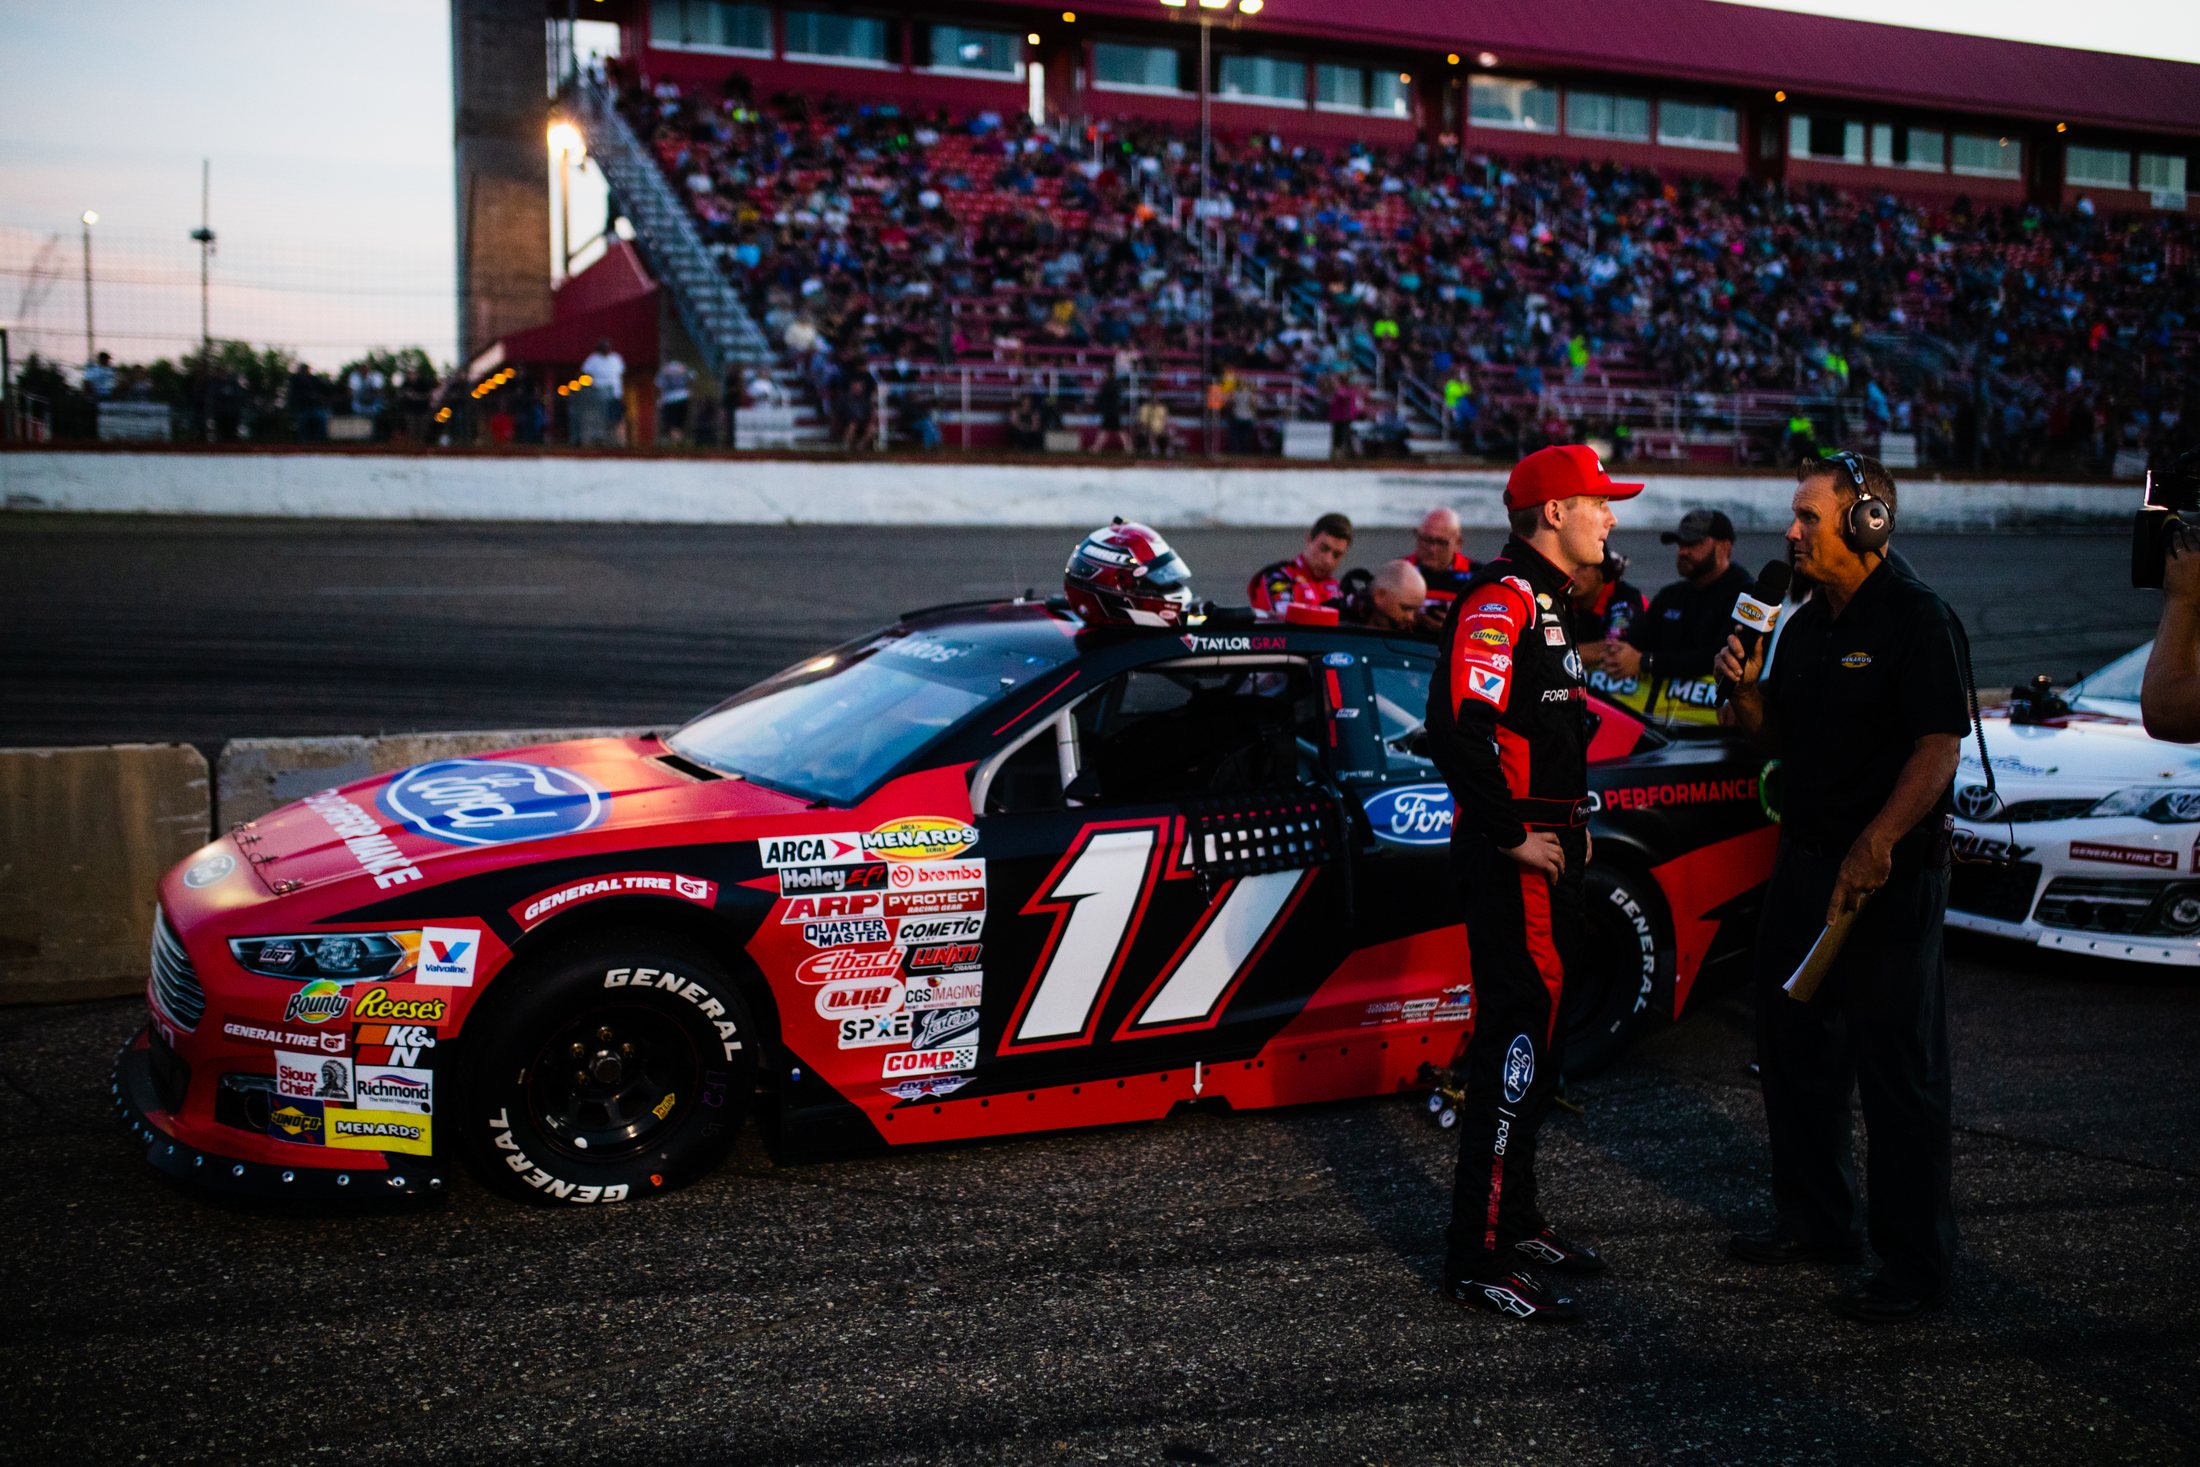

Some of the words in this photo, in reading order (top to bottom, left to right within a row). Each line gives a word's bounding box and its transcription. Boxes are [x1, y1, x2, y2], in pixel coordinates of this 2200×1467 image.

[1541, 689, 1569, 702] FORD
[1604, 778, 1761, 810] PERFORMANCE
[1391, 792, 1454, 834] For
[861, 828, 979, 850] MENARDS
[766, 839, 827, 864] ARCA
[782, 869, 848, 891] Holley
[918, 865, 982, 883] brembo
[525, 879, 622, 921] GENERAL
[623, 876, 671, 890] TIRE
[786, 893, 880, 919] ARP
[889, 891, 979, 907] PYROTECT
[907, 905, 939, 914] RACING
[804, 920, 883, 941] QUARTER
[819, 931, 888, 947] MASTER
[900, 916, 981, 939] COMETIC
[1004, 816, 1320, 1050] 17
[912, 943, 979, 967] LUNATI
[1610, 886, 1655, 1015] GENERAL
[425, 963, 468, 974] Valvoline
[799, 947, 905, 982] Eibach
[284, 993, 351, 1023] Bounty
[354, 987, 446, 1021] Reese's
[604, 967, 743, 1062] GENERAL
[223, 1022, 285, 1045] GENERAL
[284, 1032, 319, 1048] TIRE
[385, 1025, 437, 1048] K&
[388, 1046, 421, 1068] N
[887, 1050, 955, 1072] COMP
[933, 1062, 967, 1071] CAMS
[279, 1065, 318, 1083] Sioux
[1508, 1046, 1532, 1093] Ford
[279, 1080, 316, 1097] Chief
[357, 1078, 430, 1101] Richmond
[335, 1120, 421, 1139] MENARDS
[1494, 1118, 1510, 1156] FORD
[489, 1108, 630, 1204] GENERAL
